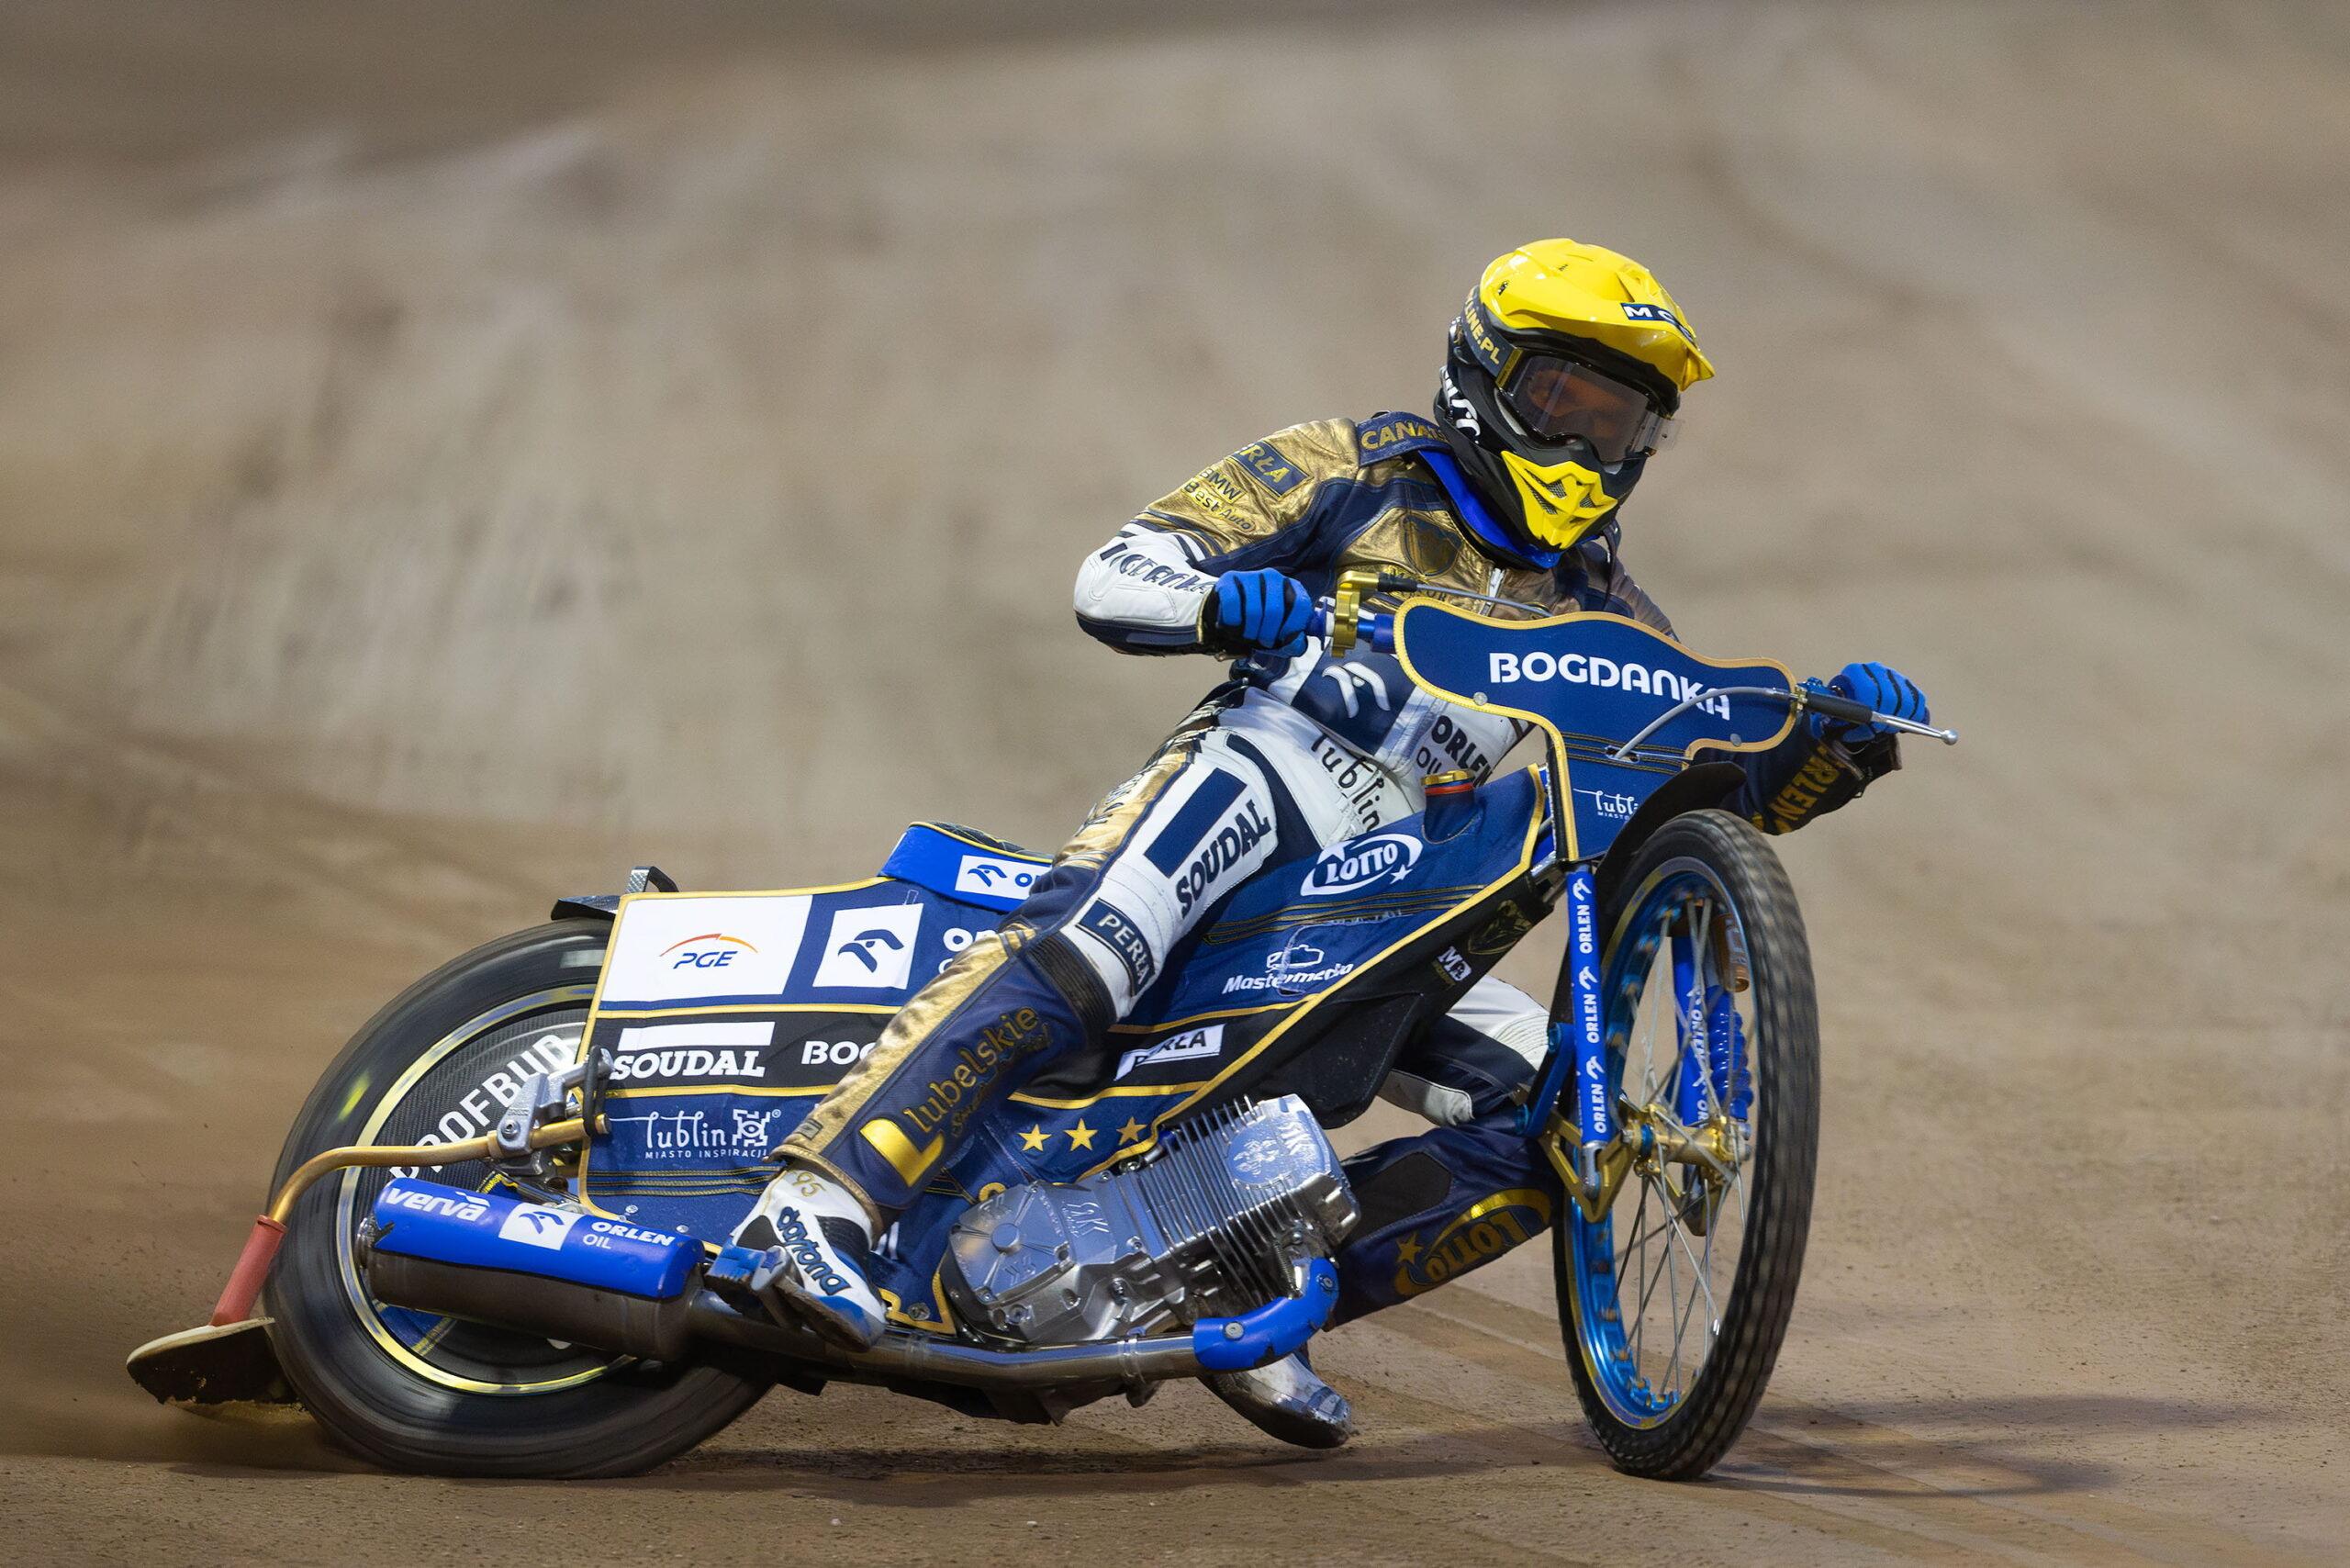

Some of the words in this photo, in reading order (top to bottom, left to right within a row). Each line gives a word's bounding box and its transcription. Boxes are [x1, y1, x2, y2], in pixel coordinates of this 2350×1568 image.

[1200, 468, 1240, 500] BMW
[1184, 481, 1220, 512] Best
[1219, 508, 1253, 530] Auto
[1489, 651, 1730, 721] BOGDANKA
[1176, 800, 1271, 919] SOUDAL
[1325, 843, 1398, 885] LOTTO
[1097, 912, 1151, 985] PERŁA
[1576, 904, 1594, 955] ORLEN
[673, 950, 738, 969] PGE
[1583, 993, 1601, 1044] ORLEN
[610, 1050, 767, 1081] SOUDAL
[1590, 1083, 1607, 1134] ORLEN
[644, 1149, 691, 1159] MIASTO
[386, 1188, 488, 1222] verva
[583, 1233, 612, 1249] OIL
[591, 1222, 676, 1247] ORLEN
